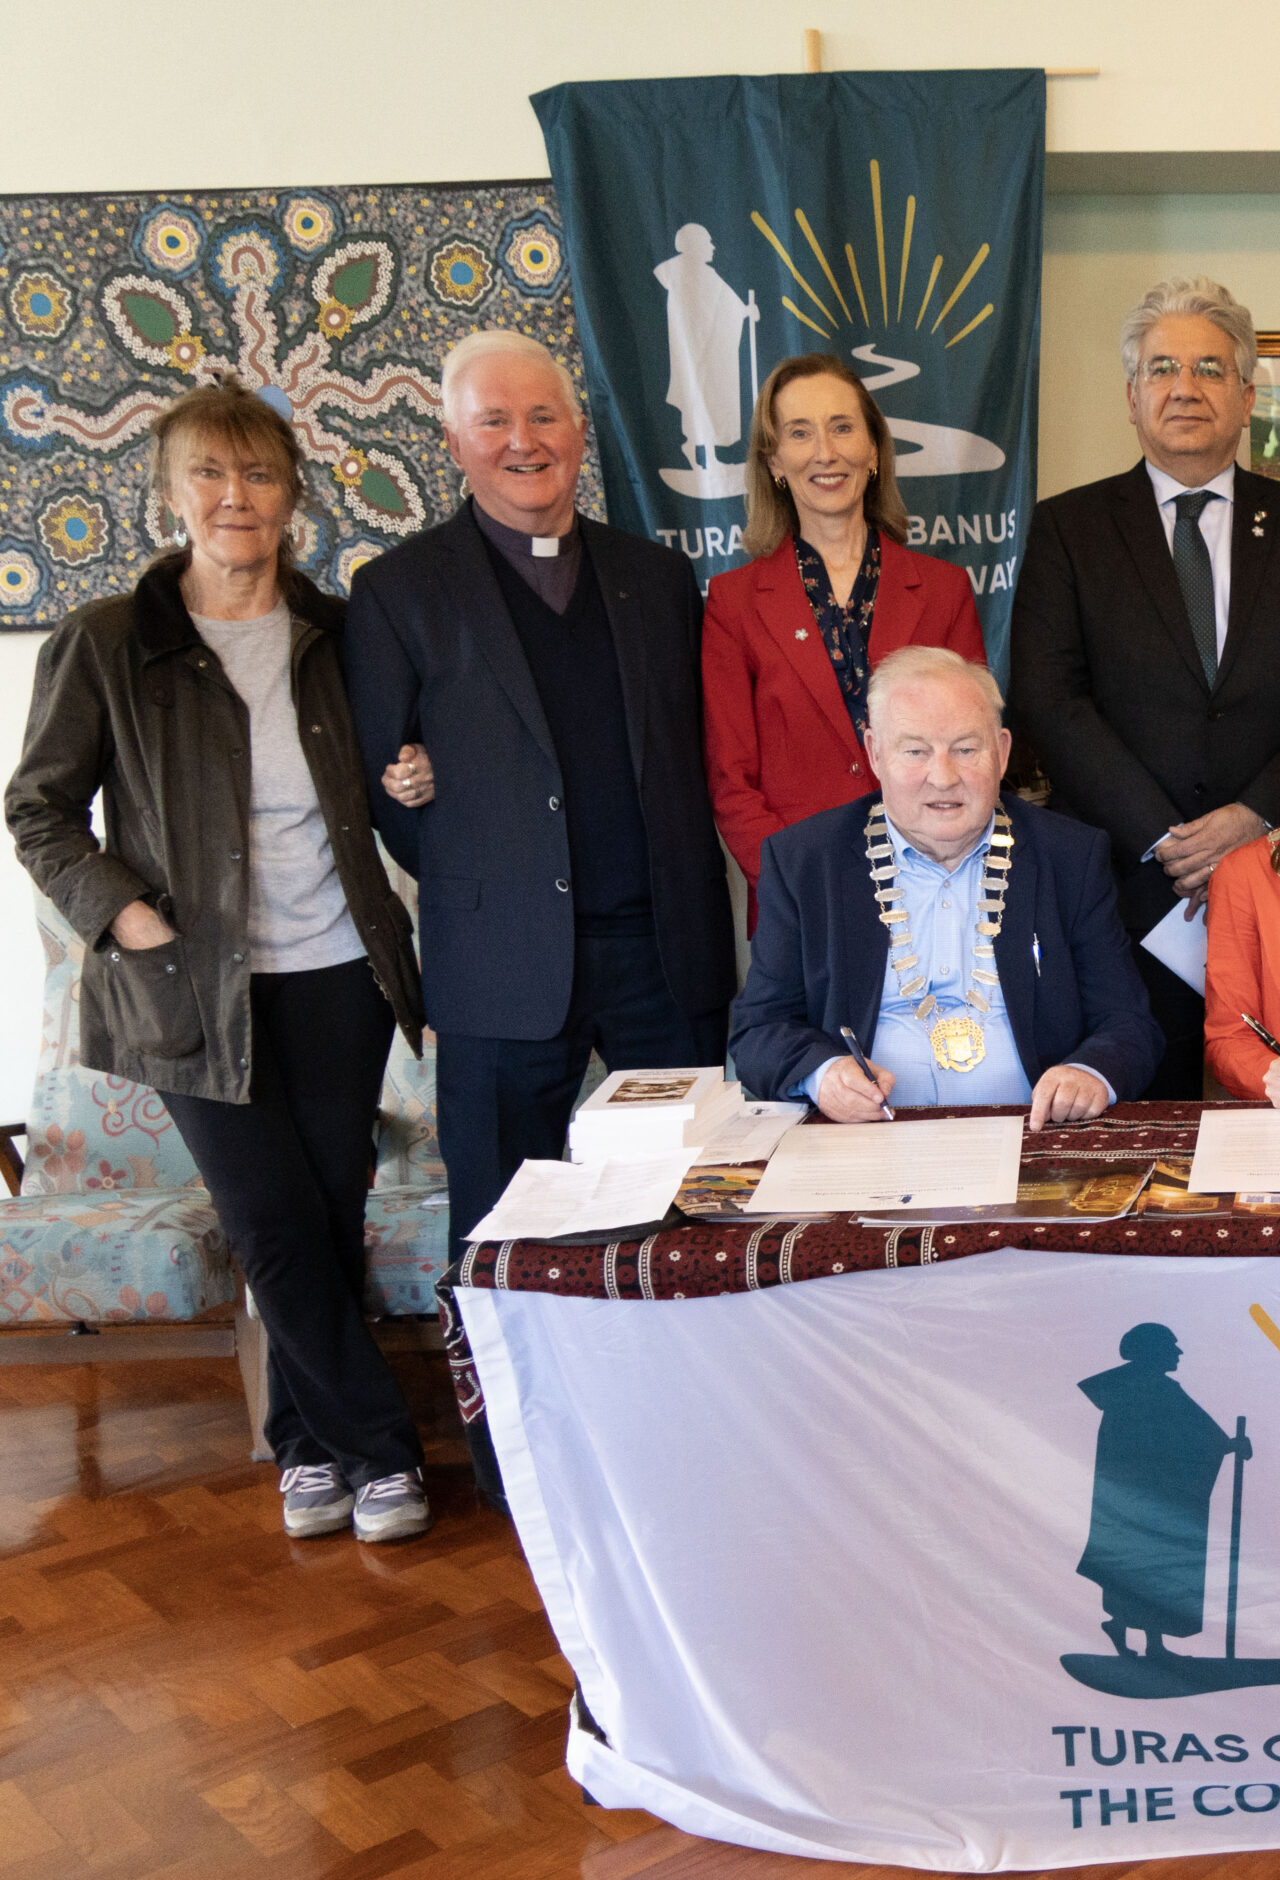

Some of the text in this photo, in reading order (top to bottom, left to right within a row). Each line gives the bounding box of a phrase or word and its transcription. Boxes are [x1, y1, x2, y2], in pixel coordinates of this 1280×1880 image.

[656, 508, 1017, 559] TURA BANUS
[1052, 1725, 1250, 1767] TURAS
[1060, 1787, 1176, 1829] THE
